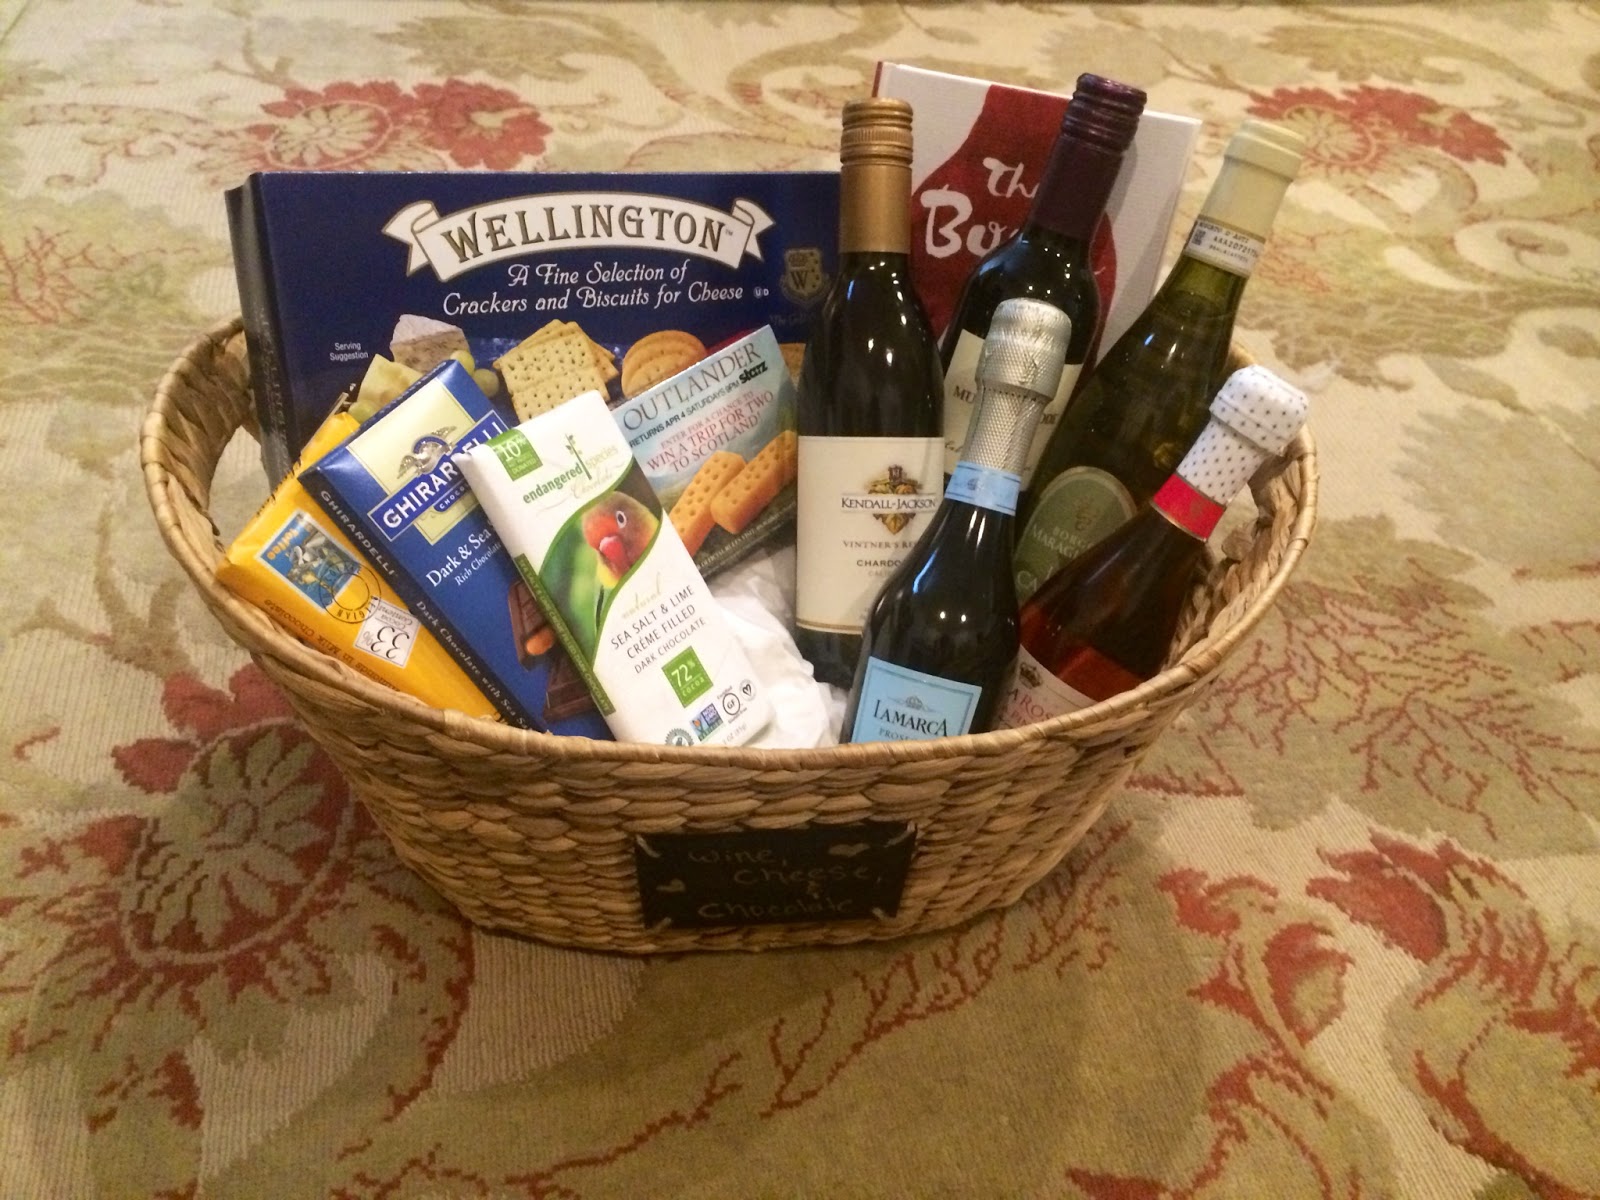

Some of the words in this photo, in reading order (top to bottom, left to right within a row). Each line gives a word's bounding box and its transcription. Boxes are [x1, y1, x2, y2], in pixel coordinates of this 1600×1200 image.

[982, 156, 1040, 198] Th
[441, 204, 725, 264] WELLINGTON
[920, 184, 1019, 258] Bo
[508, 264, 530, 287] A
[535, 263, 579, 285] Fine
[586, 261, 664, 284] Selection
[670, 259, 690, 284] of
[443, 292, 527, 316] Crackers
[535, 288, 571, 311] and
[576, 286, 649, 308] Biscuits
[654, 284, 681, 309] for
[688, 281, 743, 302] Cheese
[329, 352, 369, 362] Suggestion
[334, 342, 361, 351] Serving
[623, 342, 761, 430] OUTLANDER
[629, 425, 665, 448] RETURNS
[665, 415, 680, 430] APR
[680, 411, 686, 419] 4
[686, 388, 726, 416] SATURDAYS
[738, 360, 768, 385] starz
[647, 449, 677, 471] WIN
[679, 443, 688, 454] A
[689, 424, 717, 448] TRIP
[719, 410, 744, 430] FOR
[745, 391, 774, 414] TWO
[661, 431, 687, 448] ENTER
[689, 421, 705, 435] FOR
[705, 417, 712, 425] A
[712, 401, 743, 421] CHANCE
[383, 421, 504, 529] GHIRARELLI
[522, 463, 583, 504] endangered
[670, 455, 690, 473] TO
[439, 483, 471, 510] CHOCO
[841, 497, 936, 509] KENDALL-JACKSON
[320, 490, 395, 576] GHIRARDELLI
[843, 540, 899, 549] VINTNER'S
[902, 540, 917, 549] RE
[426, 555, 462, 587] Dark
[458, 543, 472, 560] &
[468, 528, 492, 550] Sea
[454, 566, 472, 586] Rich
[857, 559, 902, 567] CHARDO
[610, 630, 632, 650] SEA
[632, 610, 657, 635] SALT
[660, 603, 669, 614] &
[670, 585, 695, 608] LIME
[662, 604, 696, 634] FILLED
[416, 601, 440, 628] Dark
[440, 627, 481, 675] Chocolate
[482, 677, 501, 698] with
[500, 699, 516, 717] Sea
[518, 717, 533, 730] Sa
[634, 655, 657, 674] DARK
[657, 617, 707, 656] CHOCOLATE
[727, 699, 736, 710] GF
